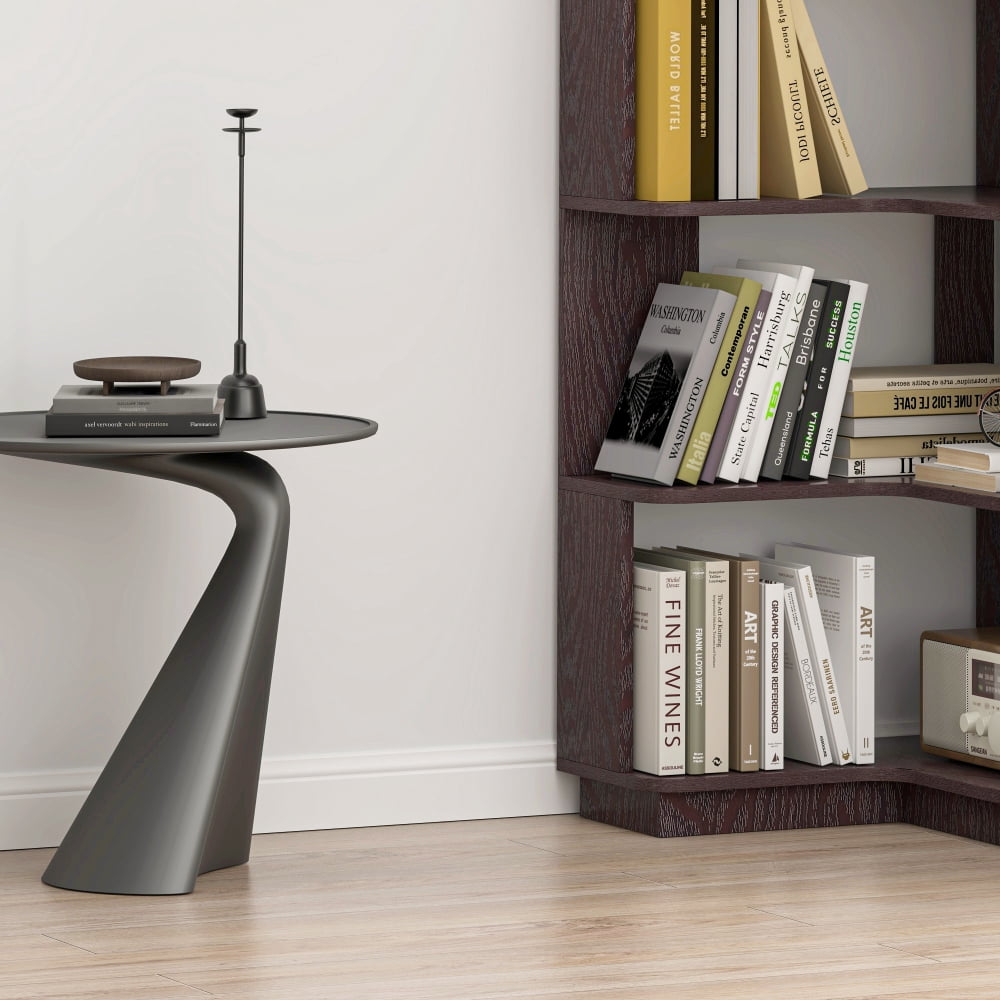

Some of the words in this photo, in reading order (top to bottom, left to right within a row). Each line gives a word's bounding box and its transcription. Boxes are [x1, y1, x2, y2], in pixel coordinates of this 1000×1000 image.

[650, 303, 706, 324] WASHINGTON
[660, 325, 682, 336] Columbia
[710, 312, 726, 345] Columbia
[757, 290, 791, 369] Harrisburg
[796, 299, 821, 366] Brisbane
[837, 302, 862, 363] Houston
[721, 306, 750, 377] Contemporan
[733, 357, 750, 397] FORM
[746, 311, 765, 354] STYLE
[765, 381, 782, 421] TED
[776, 292, 807, 370] TALKS
[801, 411, 819, 462] FORMULA
[817, 367, 828, 390] FOR
[826, 300, 842, 349] SUCCESS
[669, 377, 704, 460] WASHINGTON
[731, 435, 746, 466] State
[740, 392, 760, 435] Capital
[775, 411, 793, 466] Queensland
[686, 431, 711, 472] Italia
[819, 427, 834, 459] Tehas
[664, 600, 681, 654] FINE
[695, 628, 703, 652] FRANK
[744, 610, 757, 643] ART
[771, 600, 779, 639] GRAPHIC
[860, 606, 873, 638] ART
[695, 653, 703, 676] LLOYD
[771, 641, 779, 674] DESIGN
[822, 658, 836, 695] SAARINEN
[695, 677, 703, 706] WRIGHT
[800, 658, 817, 705] BORDEAUX
[664, 665, 681, 747] WINES
[771, 676, 779, 734] REFERENCED
[831, 696, 840, 715] EERO
